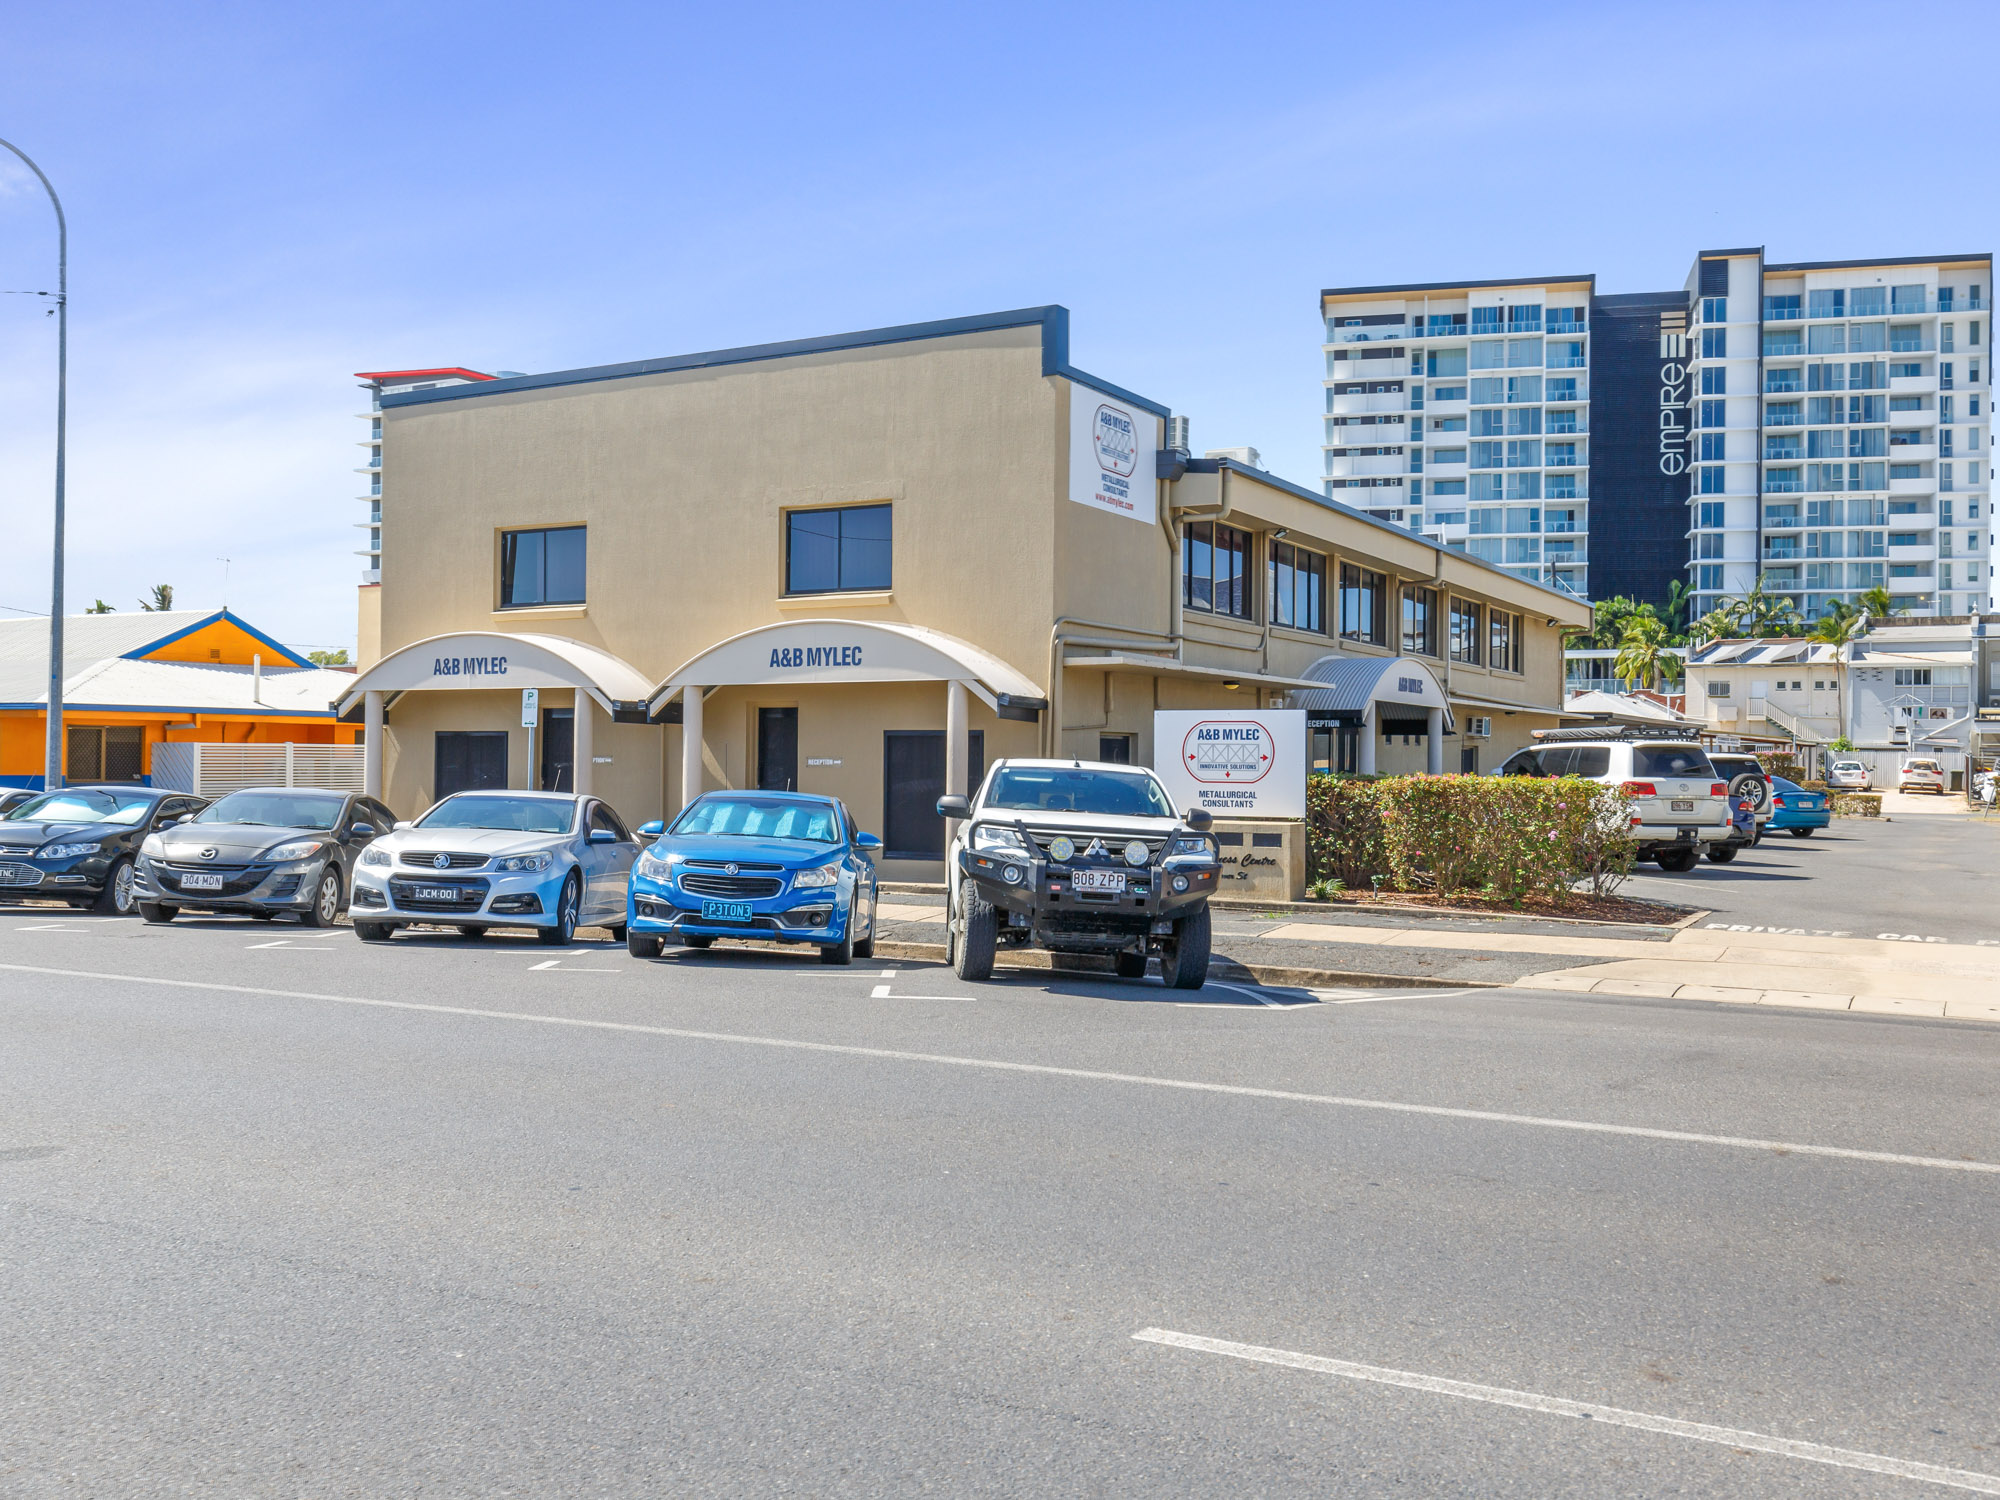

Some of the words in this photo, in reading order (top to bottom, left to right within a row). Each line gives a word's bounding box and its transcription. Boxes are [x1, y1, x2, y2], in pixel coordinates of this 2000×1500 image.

[769, 647, 804, 668] A&B
[806, 645, 862, 667] MYLEC
[433, 658, 460, 676] A&B
[463, 656, 508, 675] MYLEC
[527, 691, 534, 701] P
[1307, 719, 1340, 728] ECEPTION
[1197, 728, 1220, 741] A&B
[1222, 728, 1260, 741] MYLEC
[1198, 790, 1258, 800] METALLURGICAL
[1202, 799, 1254, 808] CONSULTANTS
[1240, 853, 1277, 868] Centre
[1704, 923, 1853, 937] PRIVATE
[1876, 932, 1949, 944] CAR
